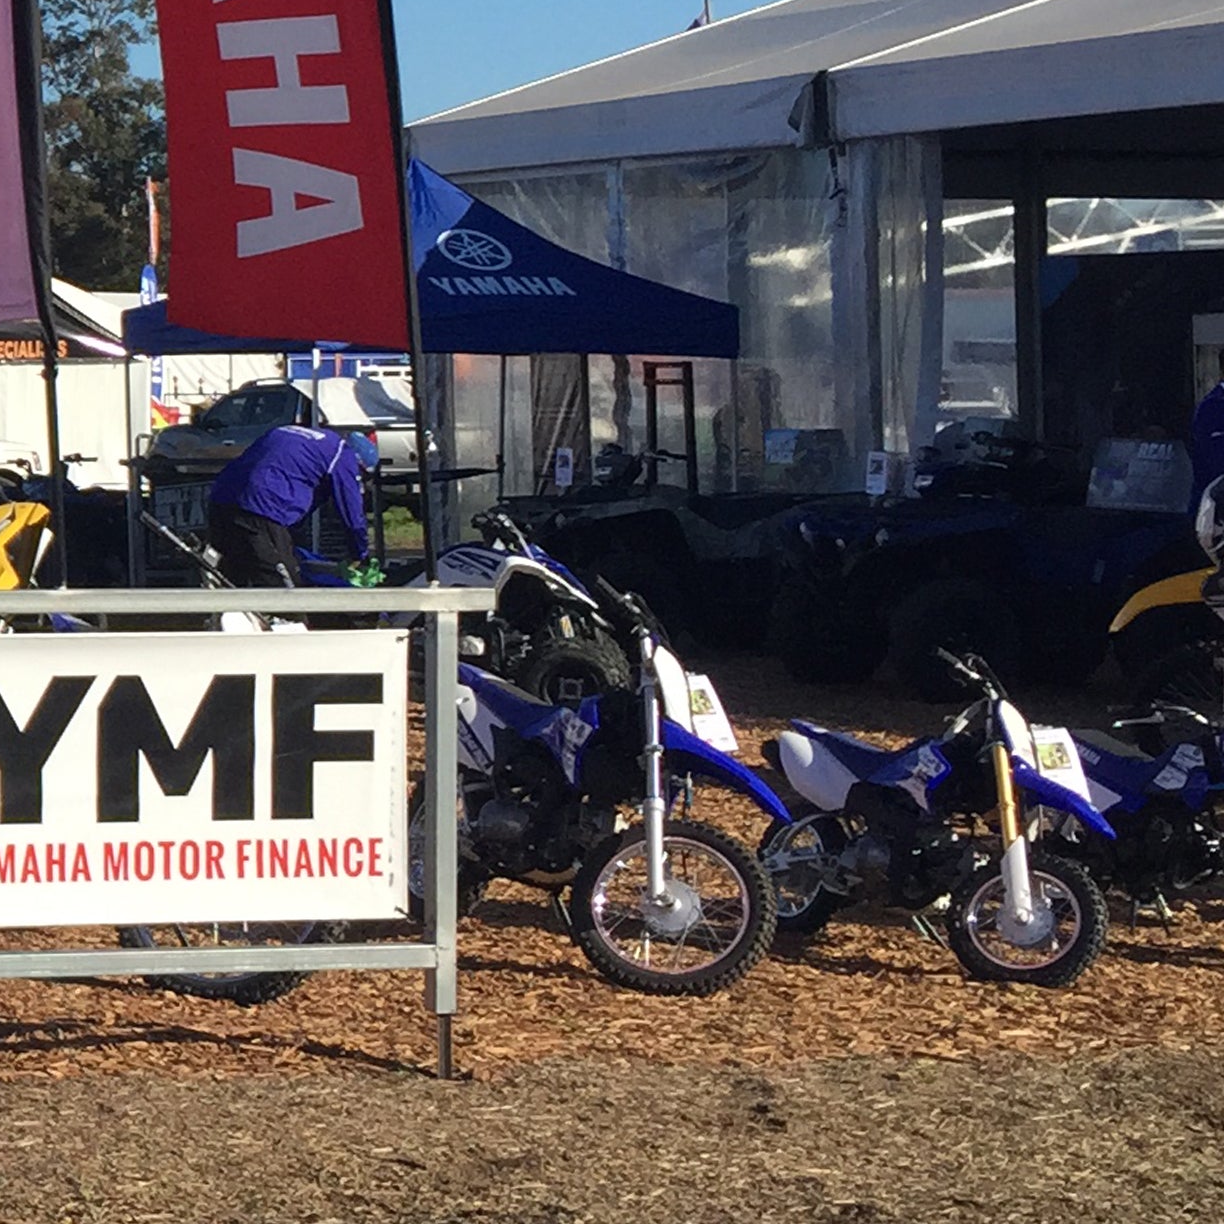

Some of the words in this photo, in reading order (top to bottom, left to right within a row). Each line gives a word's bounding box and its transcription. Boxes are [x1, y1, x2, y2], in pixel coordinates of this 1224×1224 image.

[427, 275, 577, 297] YAMAHA
[102, 839, 226, 882] MOTOR
[236, 836, 384, 878] FINANCE
